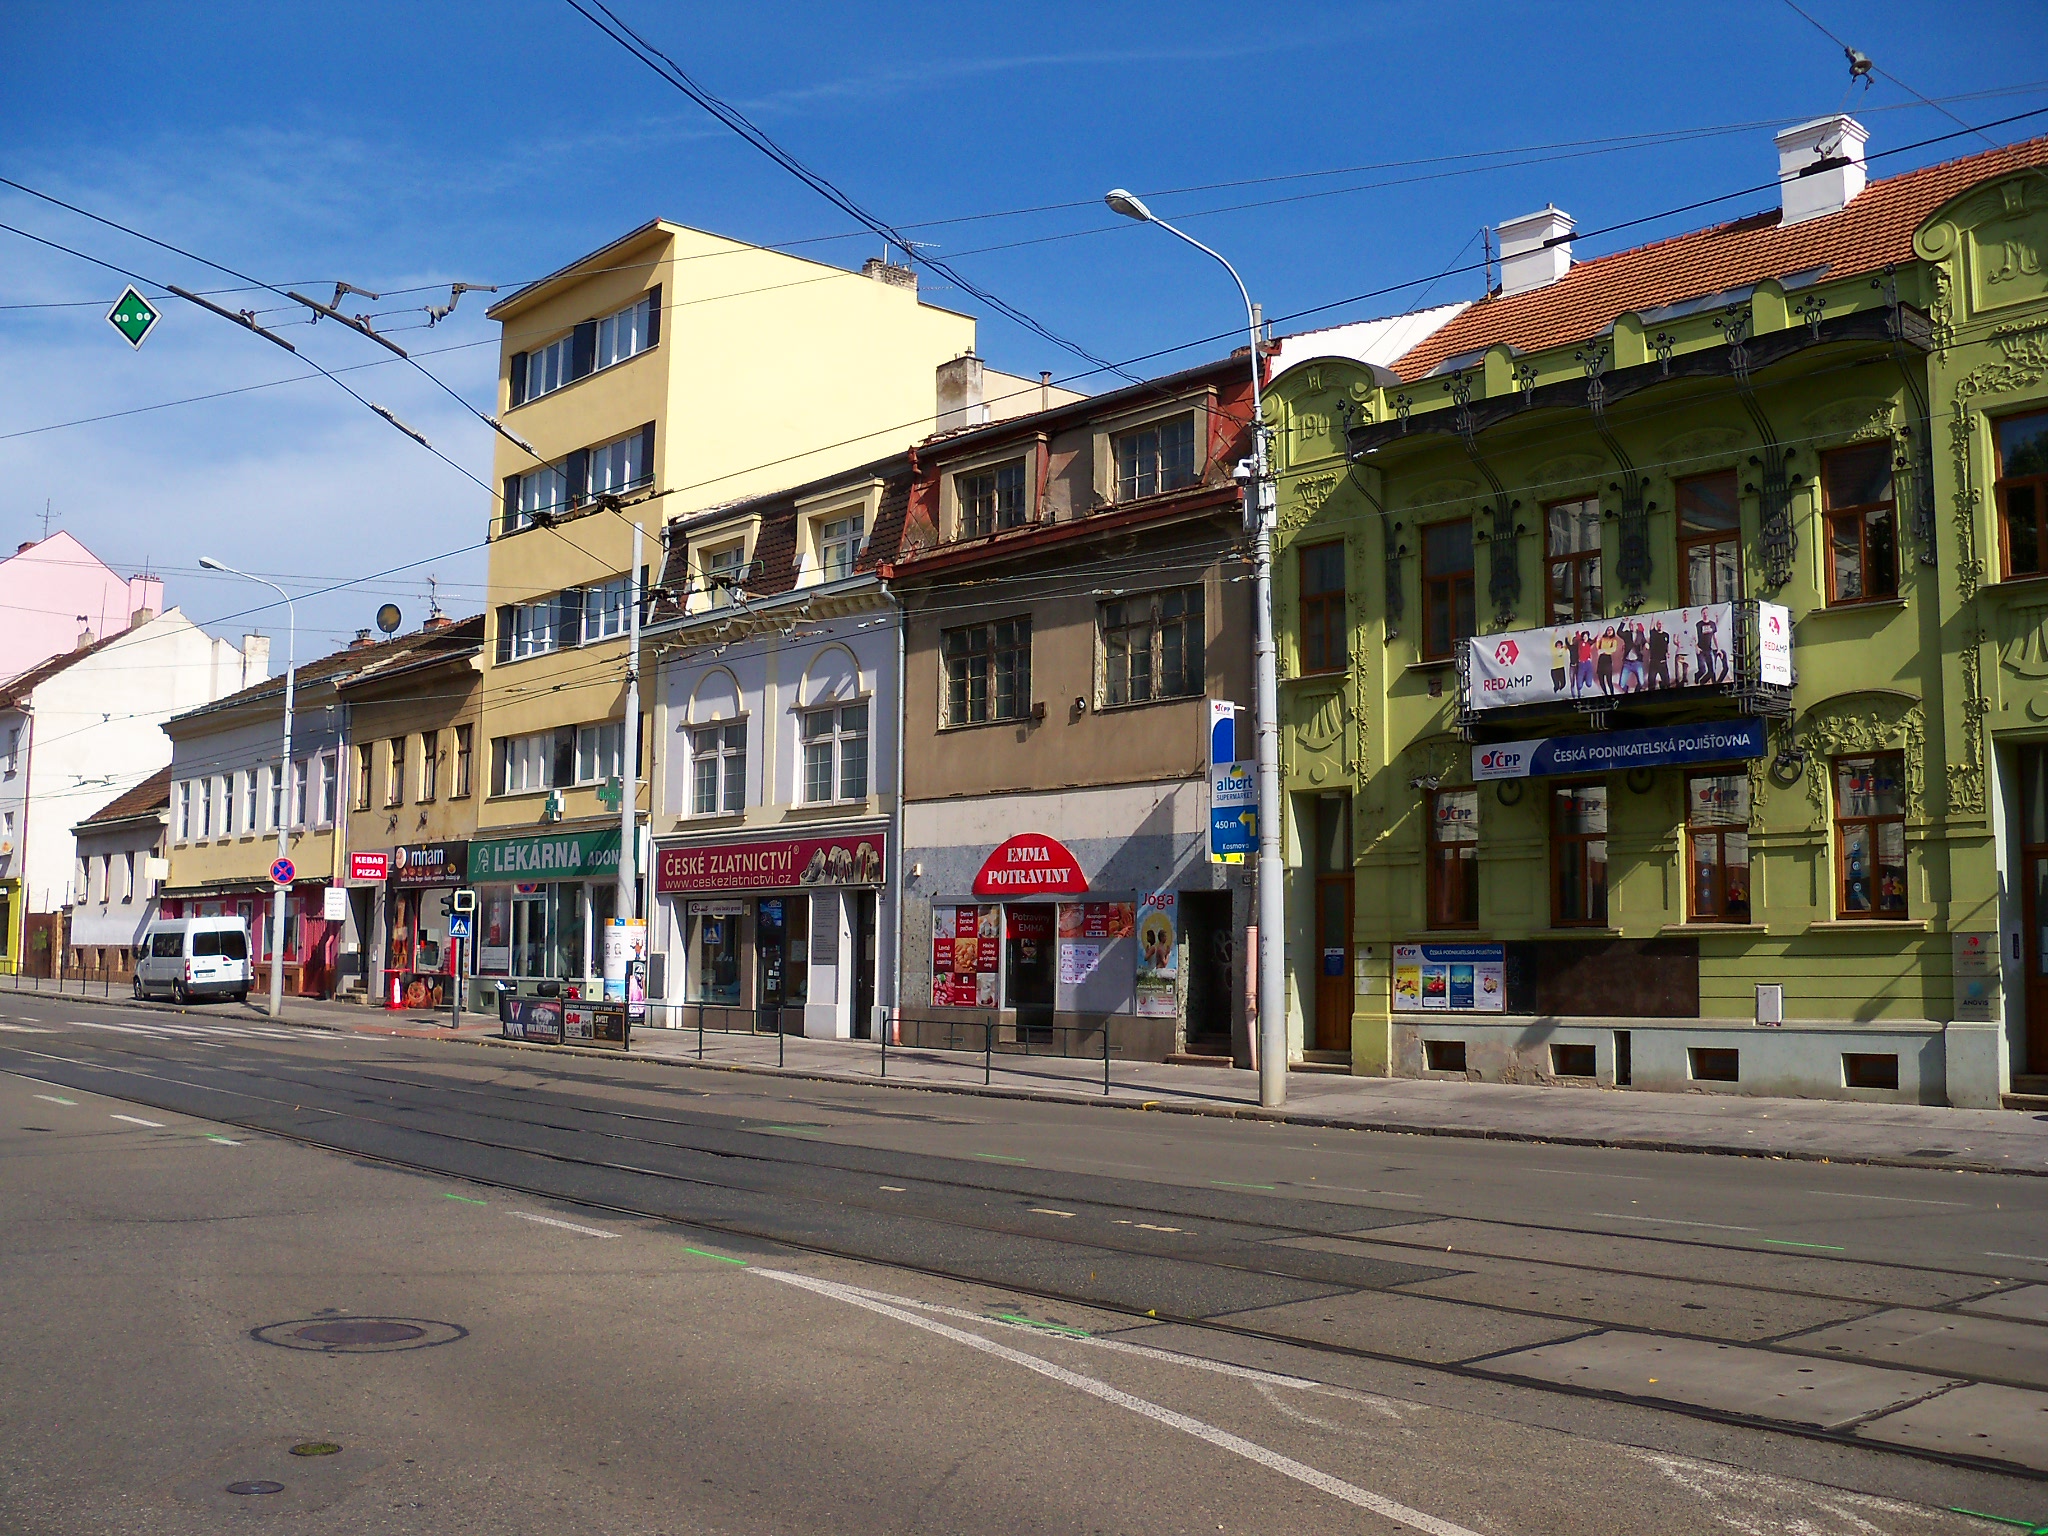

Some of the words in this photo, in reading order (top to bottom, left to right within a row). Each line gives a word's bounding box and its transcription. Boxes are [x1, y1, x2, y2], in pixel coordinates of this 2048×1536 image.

[1764, 641, 1787, 653] REDAMP
[1483, 674, 1533, 691] REDAMP
[1553, 746, 1587, 763] ČESKÁ
[1588, 737, 1676, 759] PODNIKATELSKÁ
[1678, 733, 1751, 751] POJIŠŤOVNA
[1495, 752, 1521, 767] ČPP
[1216, 775, 1253, 791] albert
[1216, 791, 1253, 801] SUPERMARKET
[1451, 806, 1472, 820] ČPP
[1215, 820, 1229, 830] 450
[1222, 842, 1250, 850] Kosmova
[354, 856, 384, 864] KEBAB
[411, 845, 444, 866] mňam
[494, 839, 581, 872] LÉKÁRNA
[587, 849, 619, 866] ADON
[1006, 846, 1050, 863] EMMA
[665, 851, 705, 876] ČESKÉ
[356, 869, 382, 877] PIZZA
[665, 872, 792, 889] www.ceskezlatnictvi.cz
[986, 868, 1071, 885] POTRAVINY
[1141, 891, 1175, 910] Jóga
[1012, 912, 1050, 923] Potraviny
[1018, 923, 1045, 932] EMMA
[1443, 948, 1475, 956] PODNIKATELSKÁ
